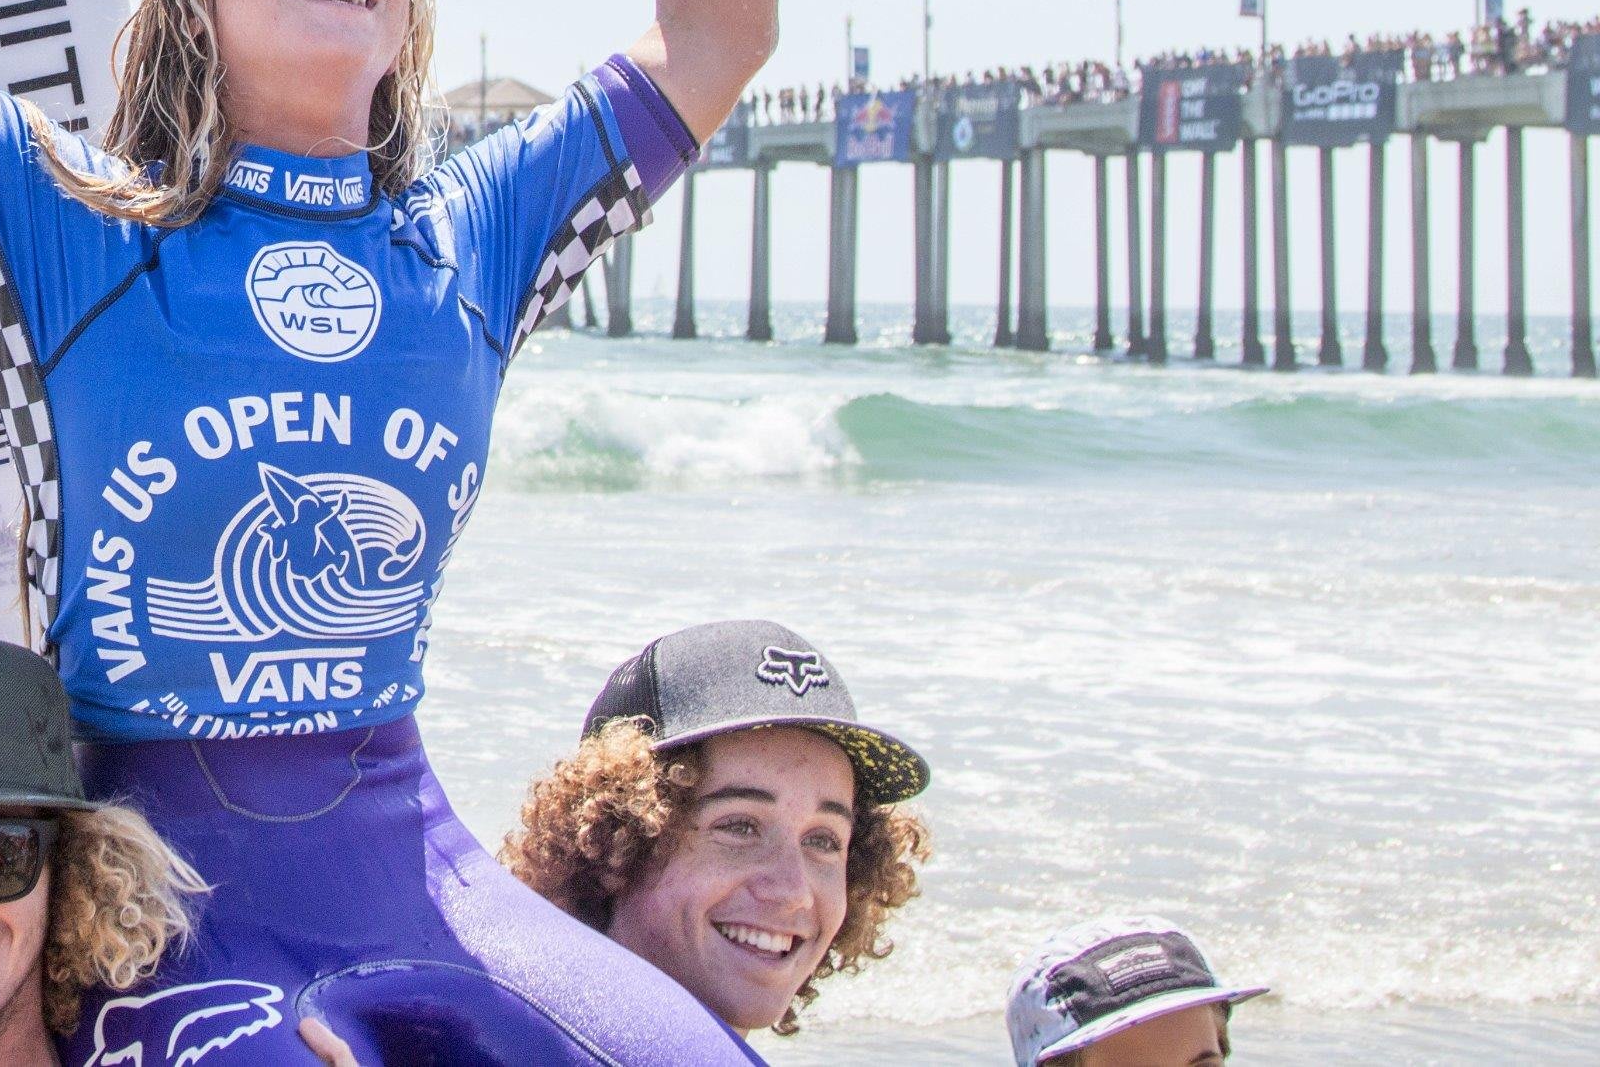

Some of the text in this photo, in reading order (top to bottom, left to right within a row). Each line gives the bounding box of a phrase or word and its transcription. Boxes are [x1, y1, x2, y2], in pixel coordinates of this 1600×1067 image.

[1293, 80, 1380, 107] GoPro
[285, 171, 335, 206] VANS
[335, 176, 364, 206] VANS
[280, 311, 357, 335] WSL
[183, 391, 351, 460] OPEN
[383, 408, 459, 472] OF
[102, 440, 177, 523] US
[86, 530, 147, 684] VANS
[209, 647, 367, 704] VANS
